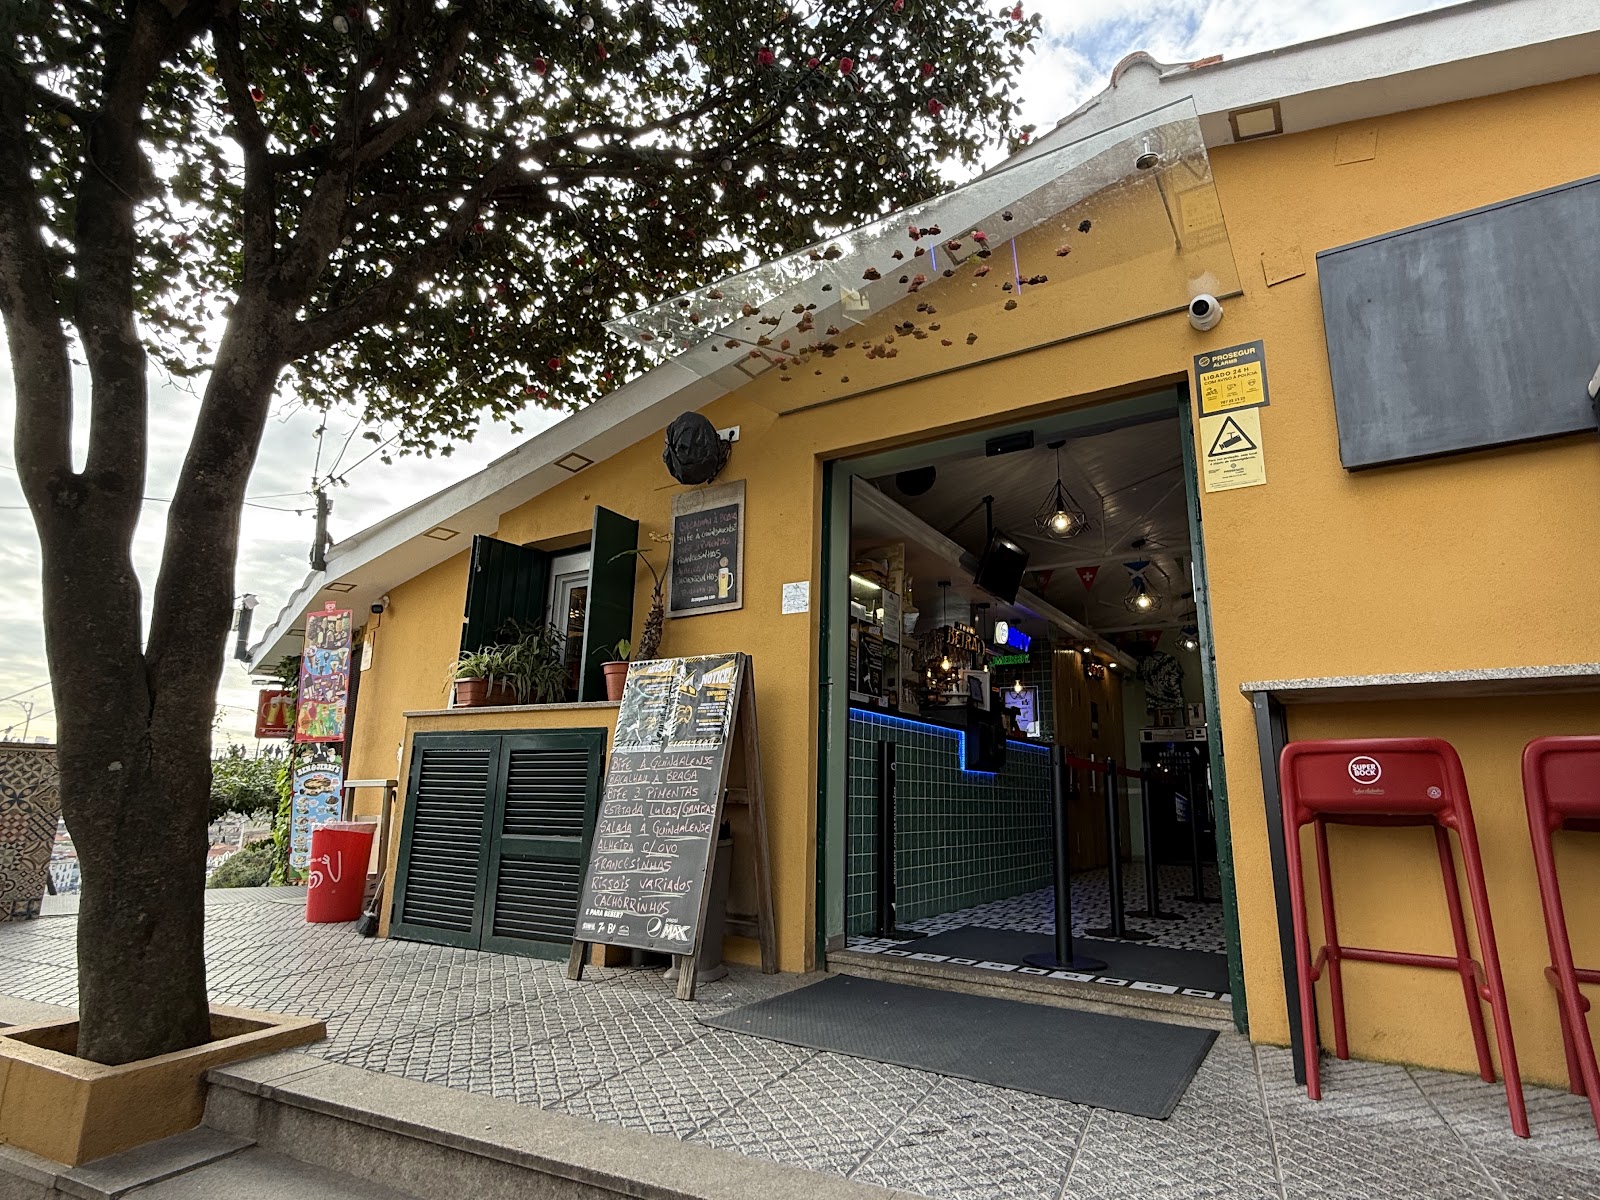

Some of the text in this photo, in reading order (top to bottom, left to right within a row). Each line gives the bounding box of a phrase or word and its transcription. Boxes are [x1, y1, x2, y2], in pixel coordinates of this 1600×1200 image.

[1211, 347, 1256, 362] PROSEGUR
[1213, 358, 1238, 368] ALARMS
[1203, 370, 1231, 381] LIGADO
[702, 666, 734, 687] NOTICE!
[611, 756, 632, 771] BIFE
[666, 769, 698, 781] BRAGA
[606, 785, 700, 800] BIFE 3 PIMENTAS
[600, 820, 633, 834] SALADA
[597, 839, 634, 853] ALHEIRA
[593, 856, 672, 873] FRANCESINHAS
[639, 875, 694, 893] VARIADOS
[593, 894, 671, 915] CACHORRINHOS
[585, 908, 624, 919] E PARA BEBER?
[660, 923, 691, 942] MAX
